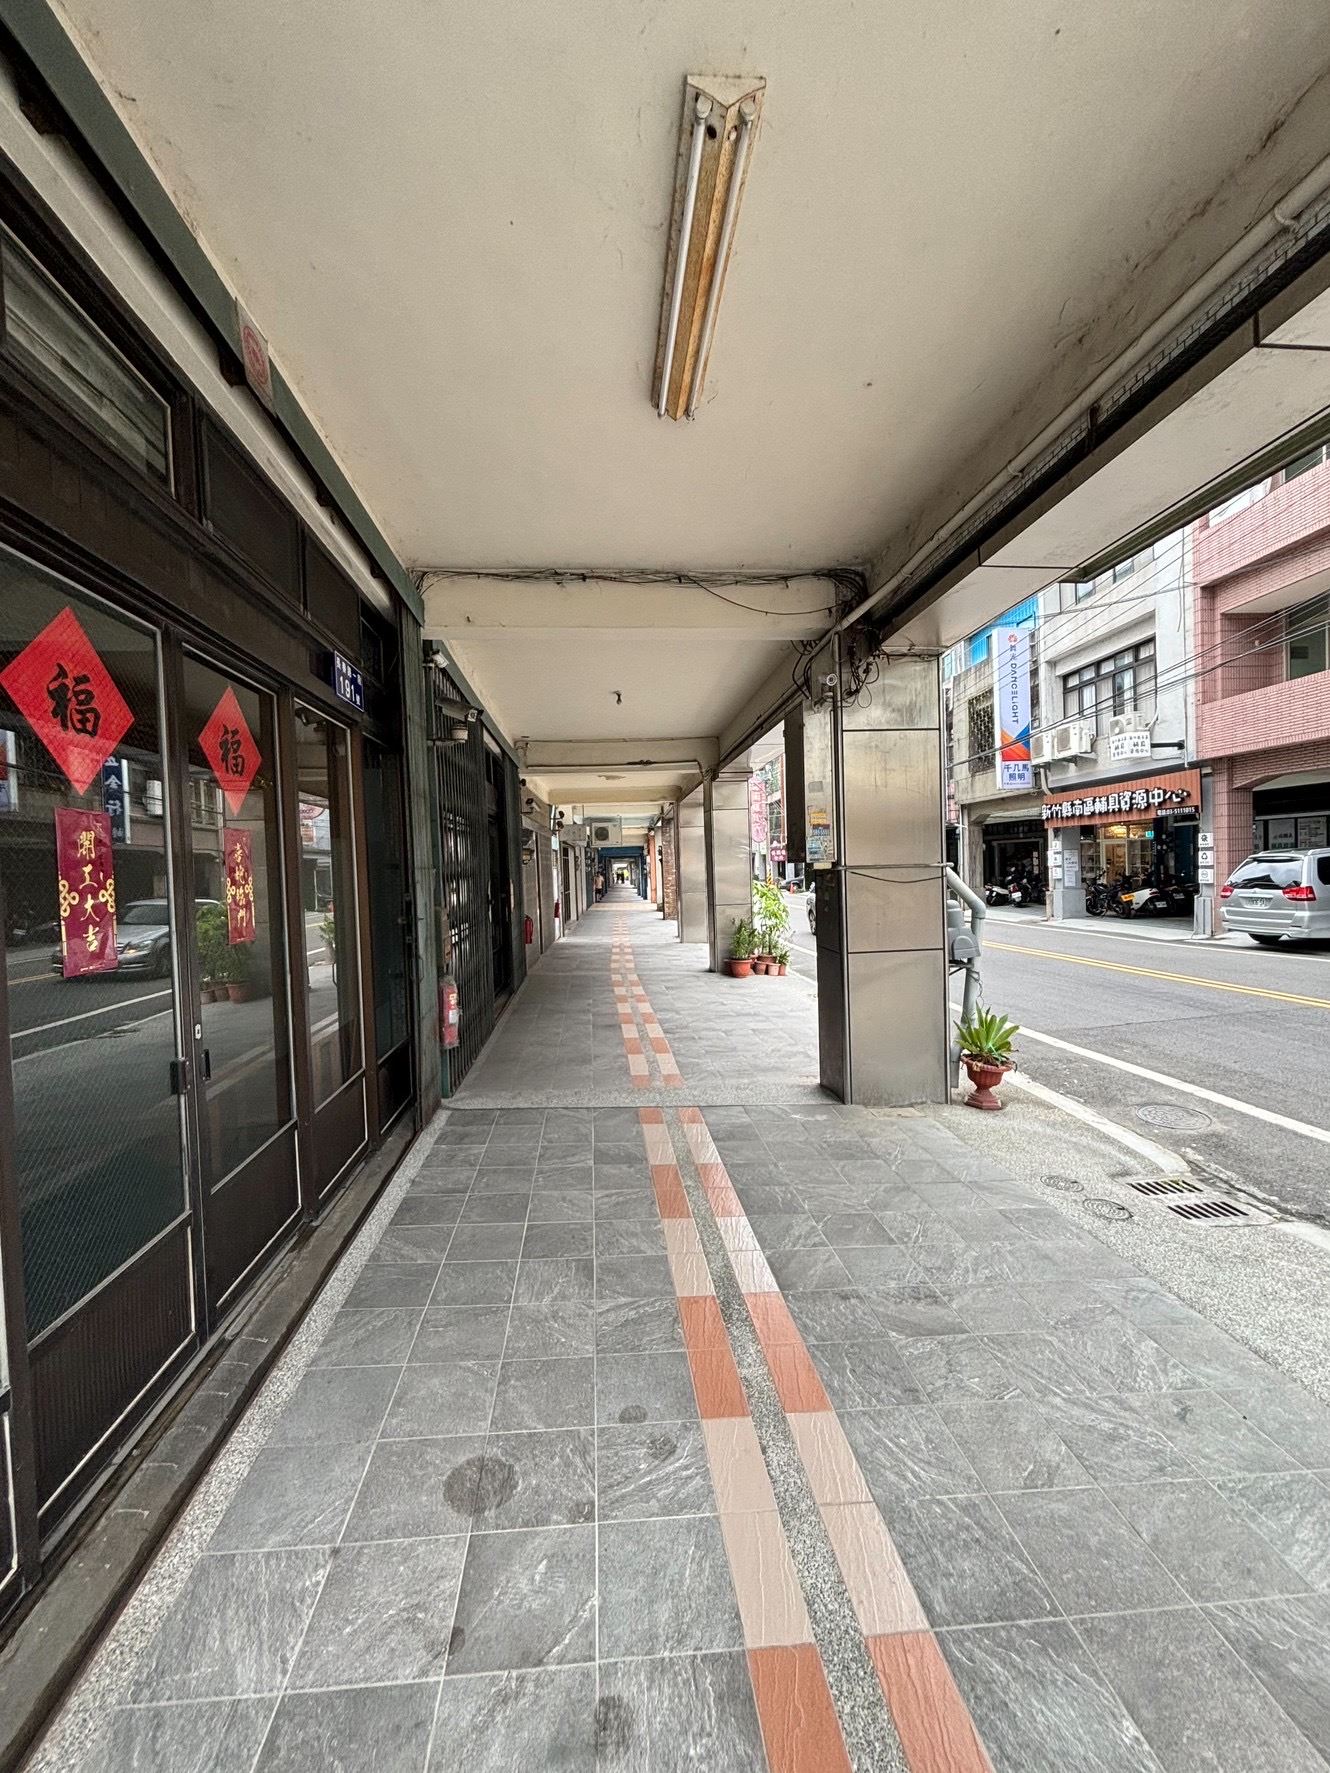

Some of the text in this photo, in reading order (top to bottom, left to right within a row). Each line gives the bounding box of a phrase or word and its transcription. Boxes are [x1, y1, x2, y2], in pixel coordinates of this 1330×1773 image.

[46, 662, 101, 738] 福
[1010, 662, 1019, 724] DANCELIGHT
[219, 723, 245, 777] 福
[1008, 772, 1026, 782] 照明
[1041, 788, 1189, 820] 新竹縣南區輔具資源中心
[77, 830, 100, 953] 開工大吉
